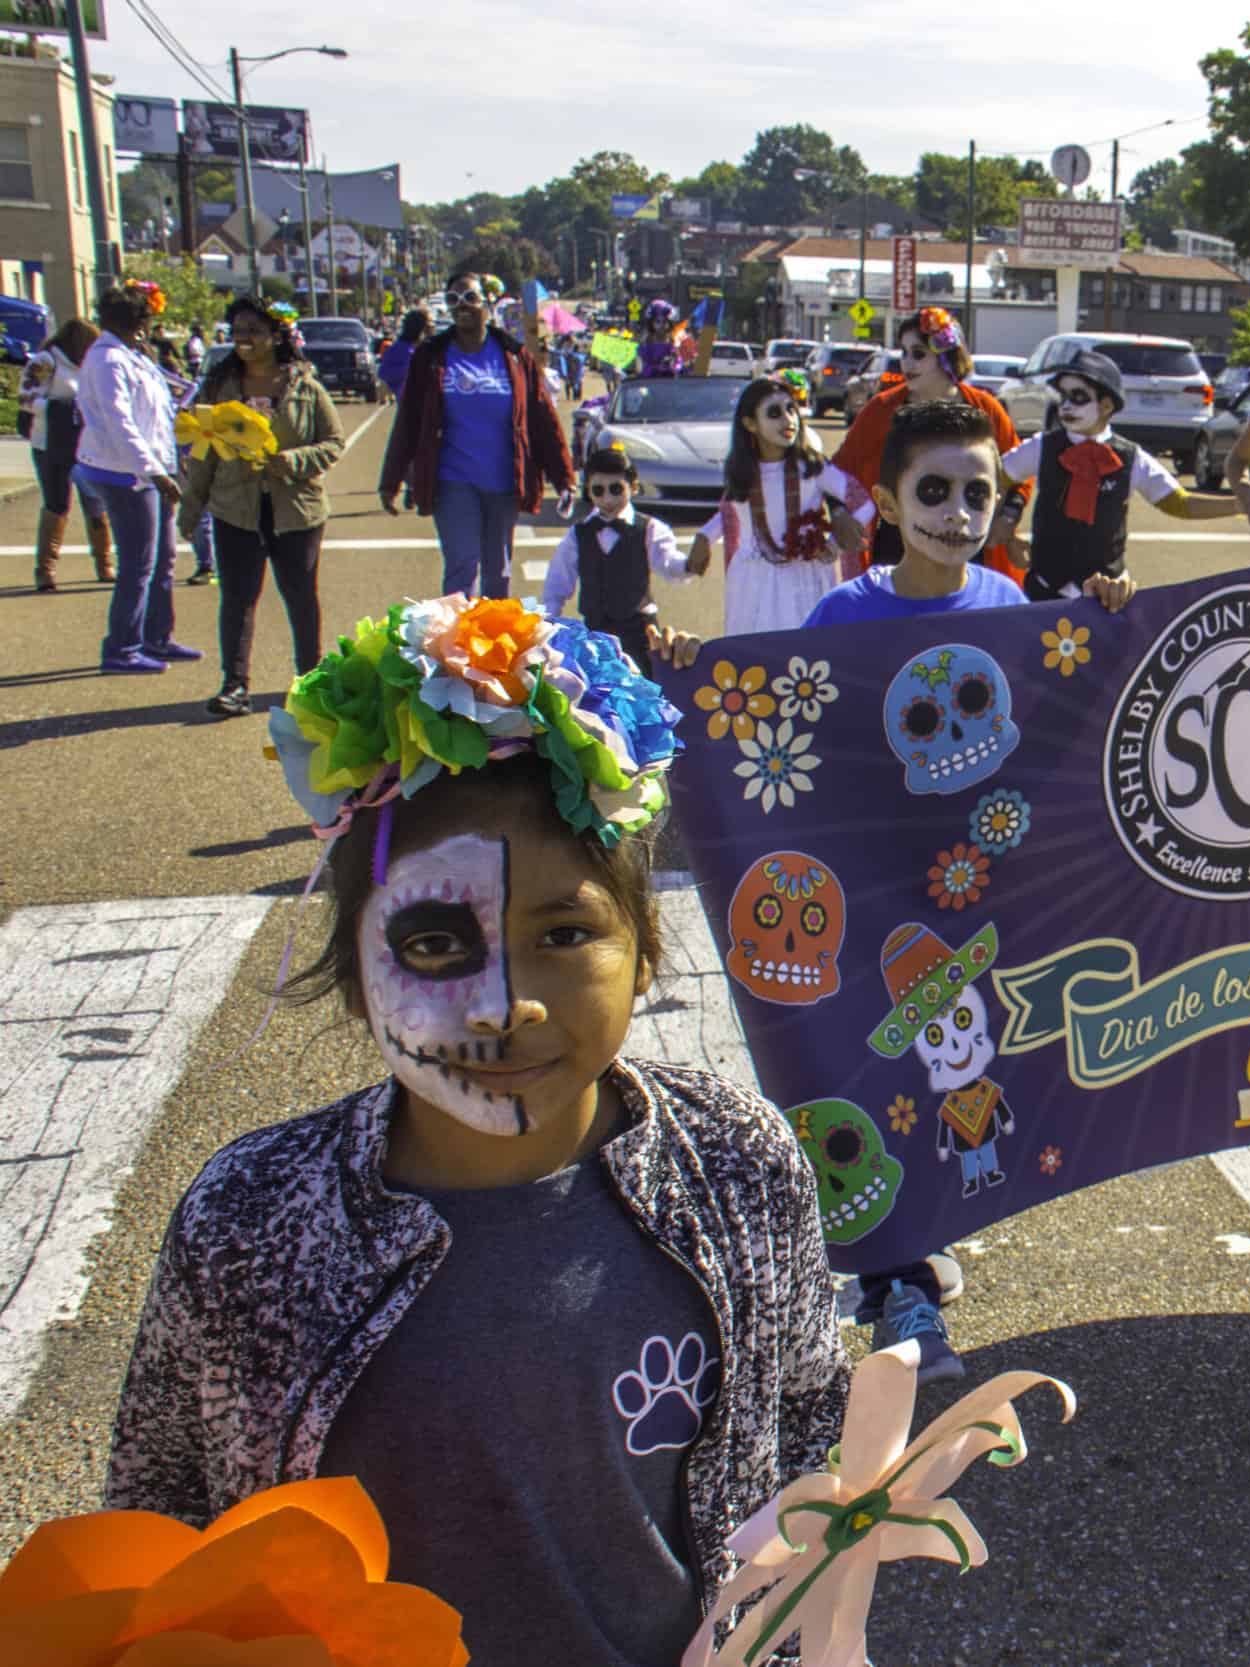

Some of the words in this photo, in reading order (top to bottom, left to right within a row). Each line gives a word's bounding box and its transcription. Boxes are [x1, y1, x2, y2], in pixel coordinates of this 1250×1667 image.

[1118, 677, 1164, 818] SHELBY
[1156, 840, 1243, 884] Excellence
[1097, 1018, 1159, 1060] Dia
[1165, 983, 1205, 1030] de
